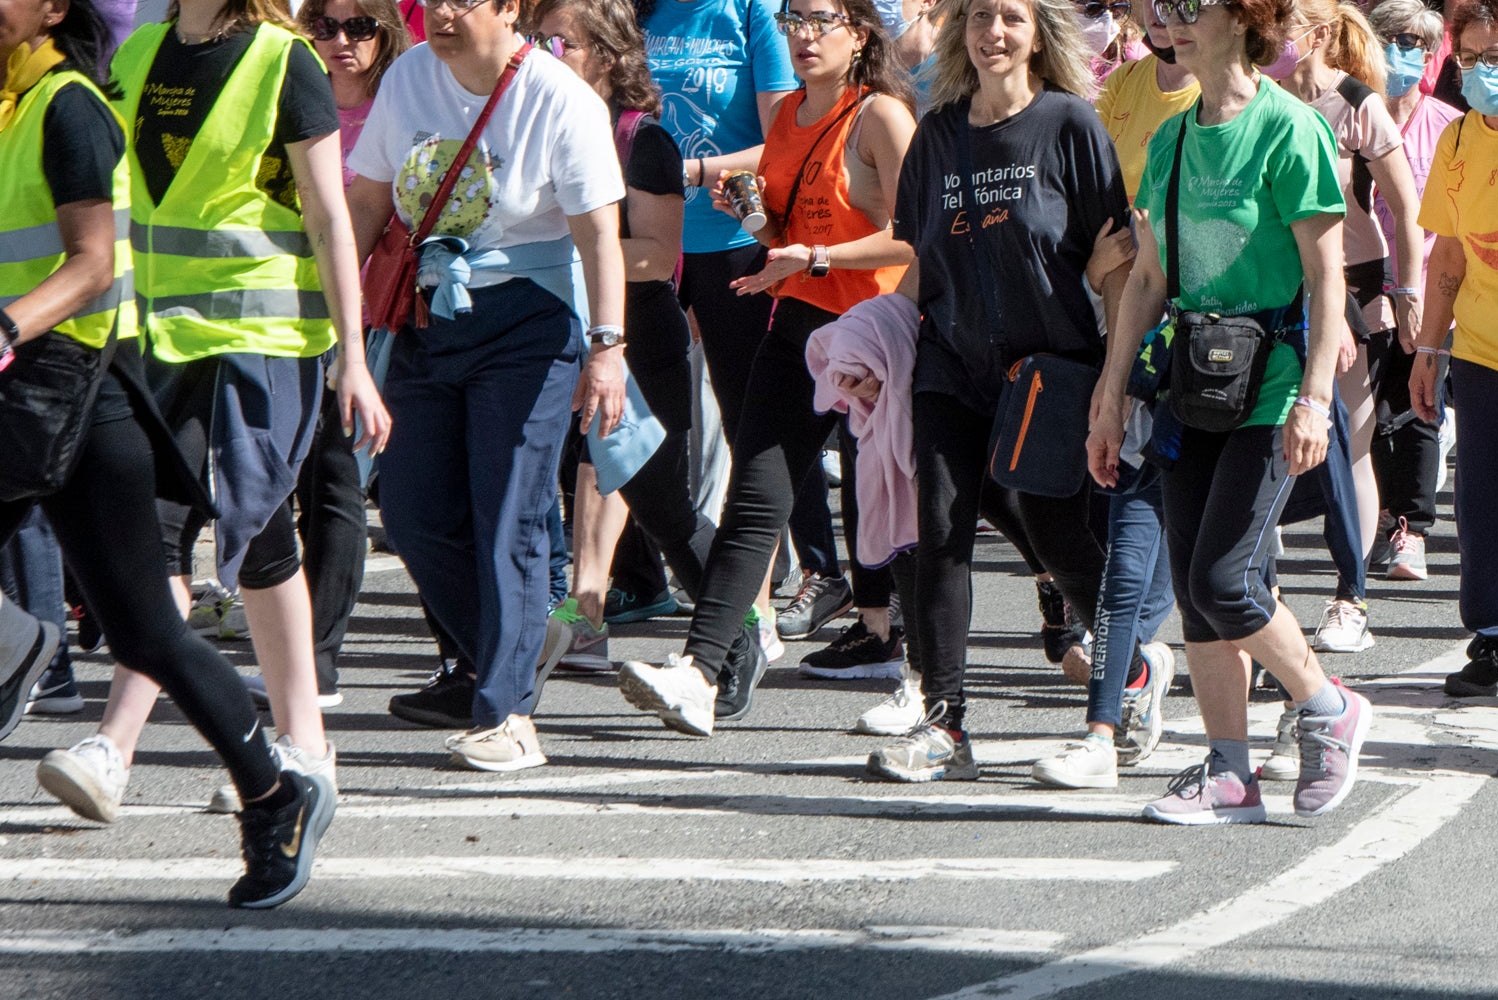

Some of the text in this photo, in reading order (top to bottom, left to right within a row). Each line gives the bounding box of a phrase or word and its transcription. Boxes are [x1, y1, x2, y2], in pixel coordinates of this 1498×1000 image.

[681, 67, 728, 104] 2018
[1200, 188, 1240, 200] Mujeres
[1232, 178, 1243, 187] de
[942, 185, 1022, 210] Telfónica
[951, 207, 1009, 235] Esaña
[1094, 608, 1111, 680] EVERYDAY
